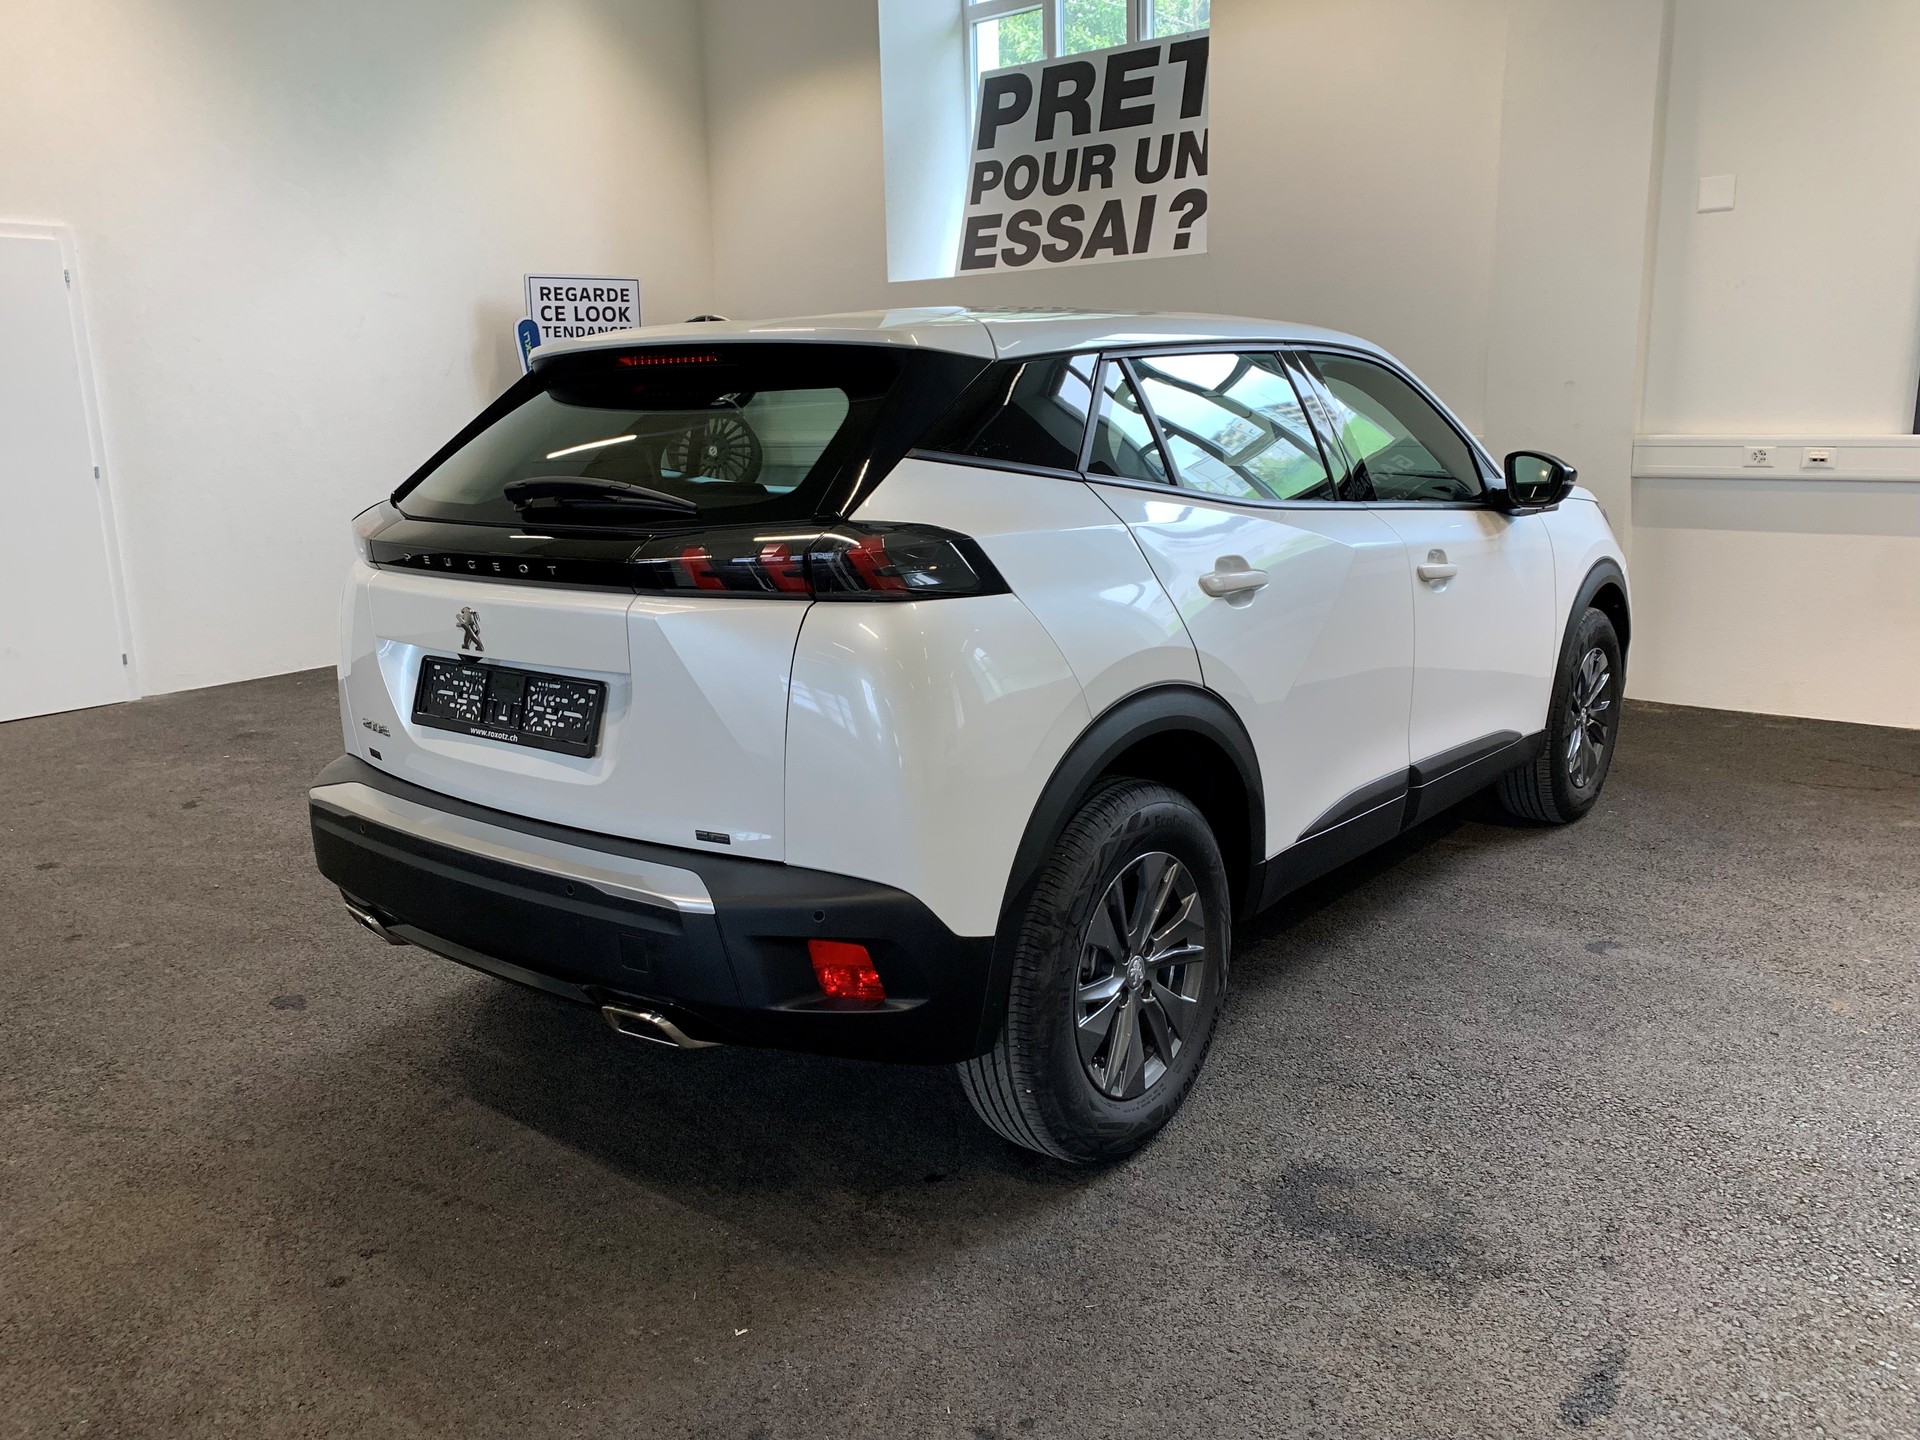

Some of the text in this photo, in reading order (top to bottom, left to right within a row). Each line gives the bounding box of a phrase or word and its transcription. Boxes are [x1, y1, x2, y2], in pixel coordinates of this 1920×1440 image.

[977, 36, 1209, 150] PRET
[970, 128, 1208, 205] POUR UN
[960, 188, 1208, 271] ESSAI ?
[539, 286, 630, 302] REGARDE
[540, 305, 631, 322] CE LOOK
[404, 553, 557, 576] PEUGEOT
[470, 727, 518, 742] www.roxotz.ch
